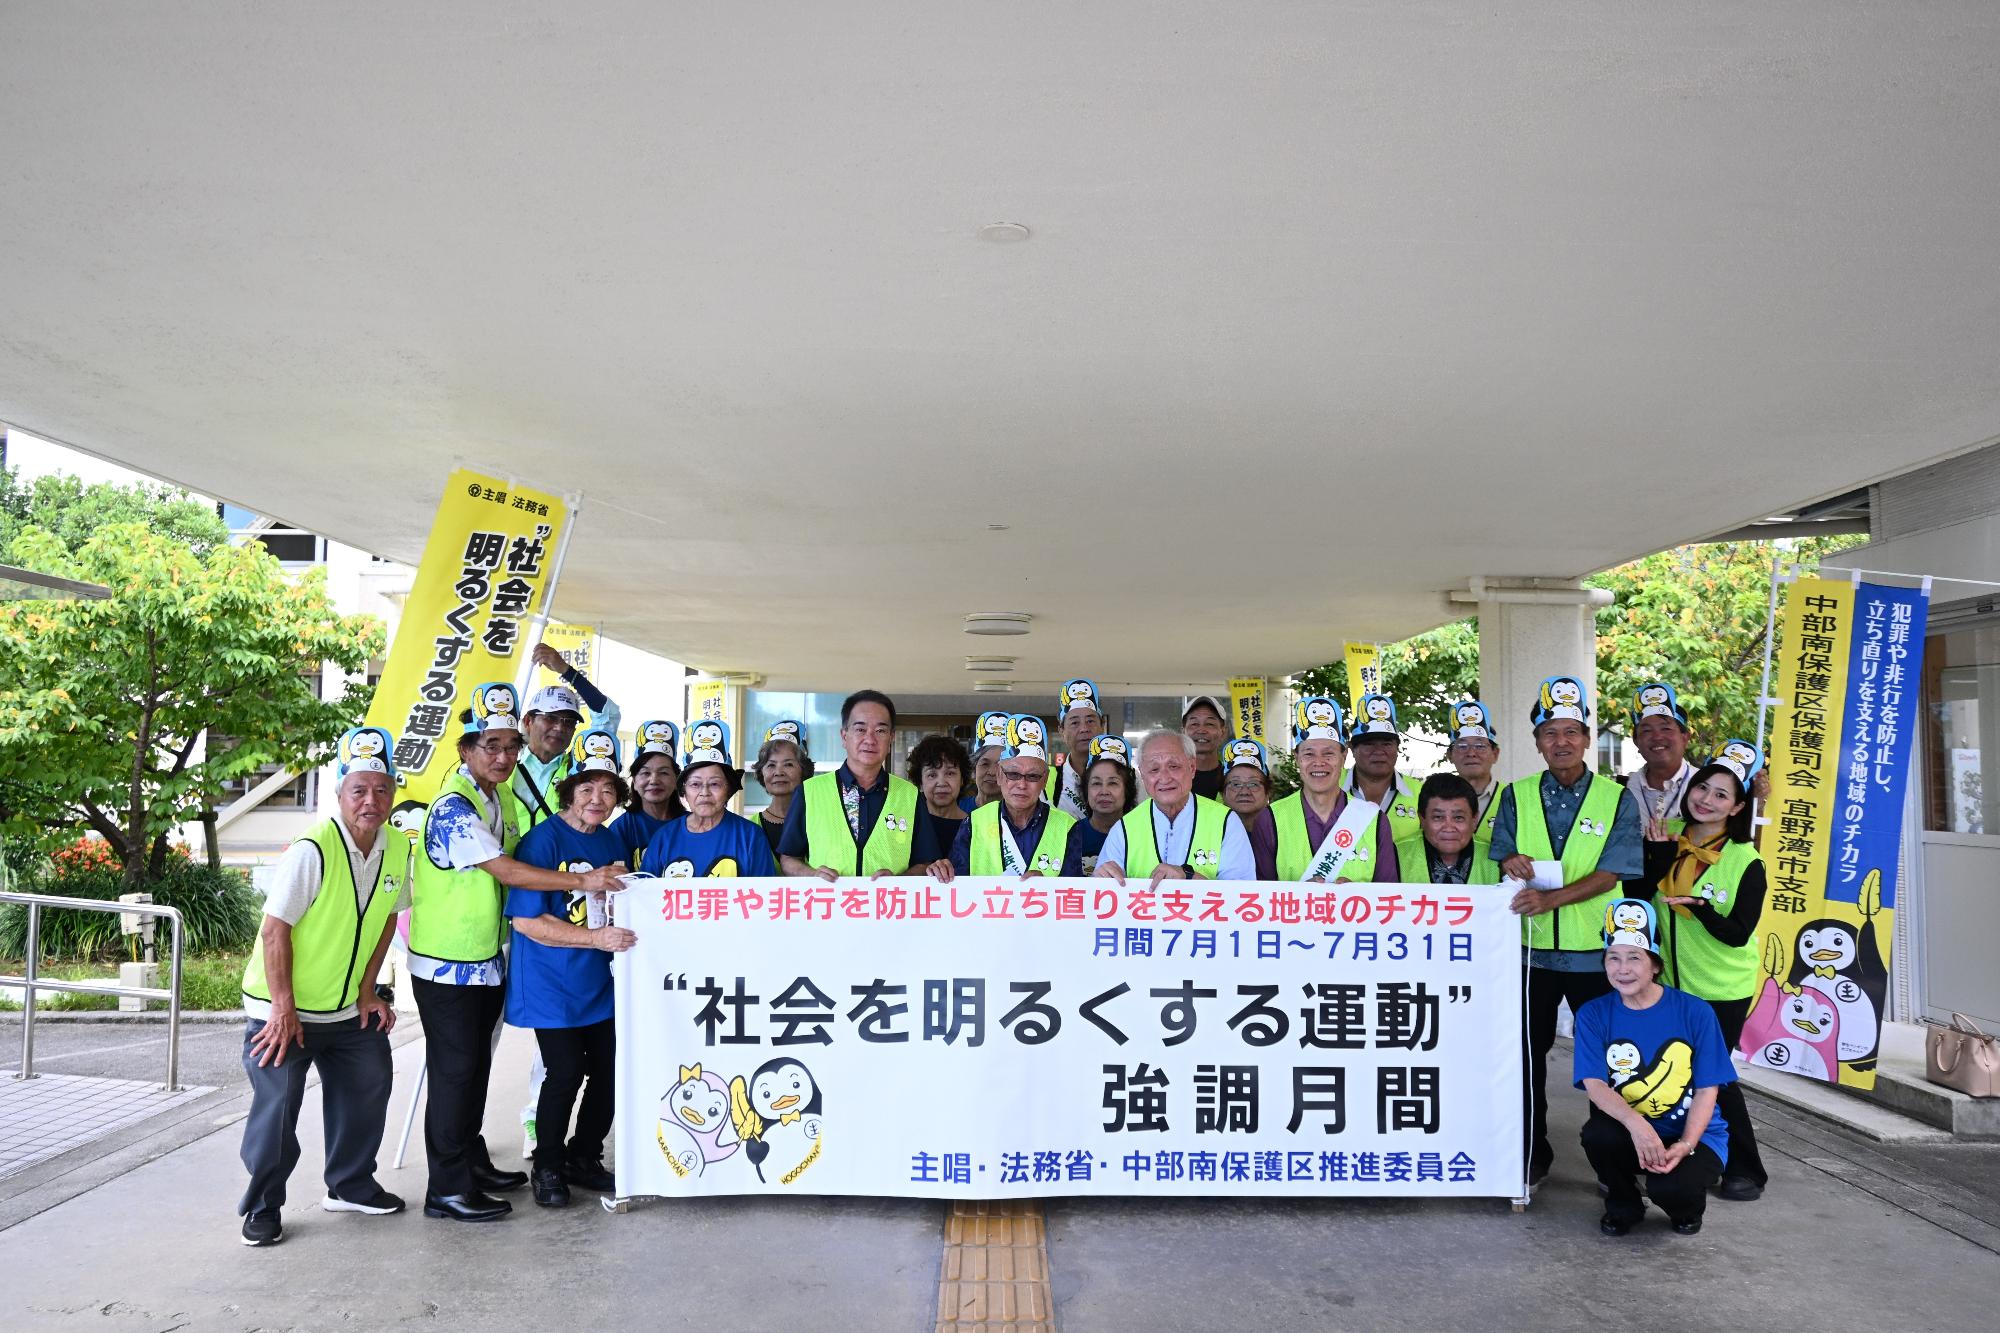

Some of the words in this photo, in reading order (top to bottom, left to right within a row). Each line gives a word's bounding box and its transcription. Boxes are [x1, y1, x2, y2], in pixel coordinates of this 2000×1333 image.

[482, 488, 507, 504] 主唱
[512, 496, 549, 516] 法務省
[1786, 595, 1838, 789] 中部南保護区保護司会
[1873, 602, 1912, 793] 犯罪や非行を防止し、
[1839, 600, 1887, 883] 立ち直りを支える地域のチカラ
[1772, 798, 1817, 914] 宜野湾市支部
[661, 886, 1473, 926] 犯罪や非行を防止し立ち直りを支える地域のチカラ
[1102, 1062, 1440, 1135] 強調月間
[658, 1136, 684, 1177] SARACHAN
